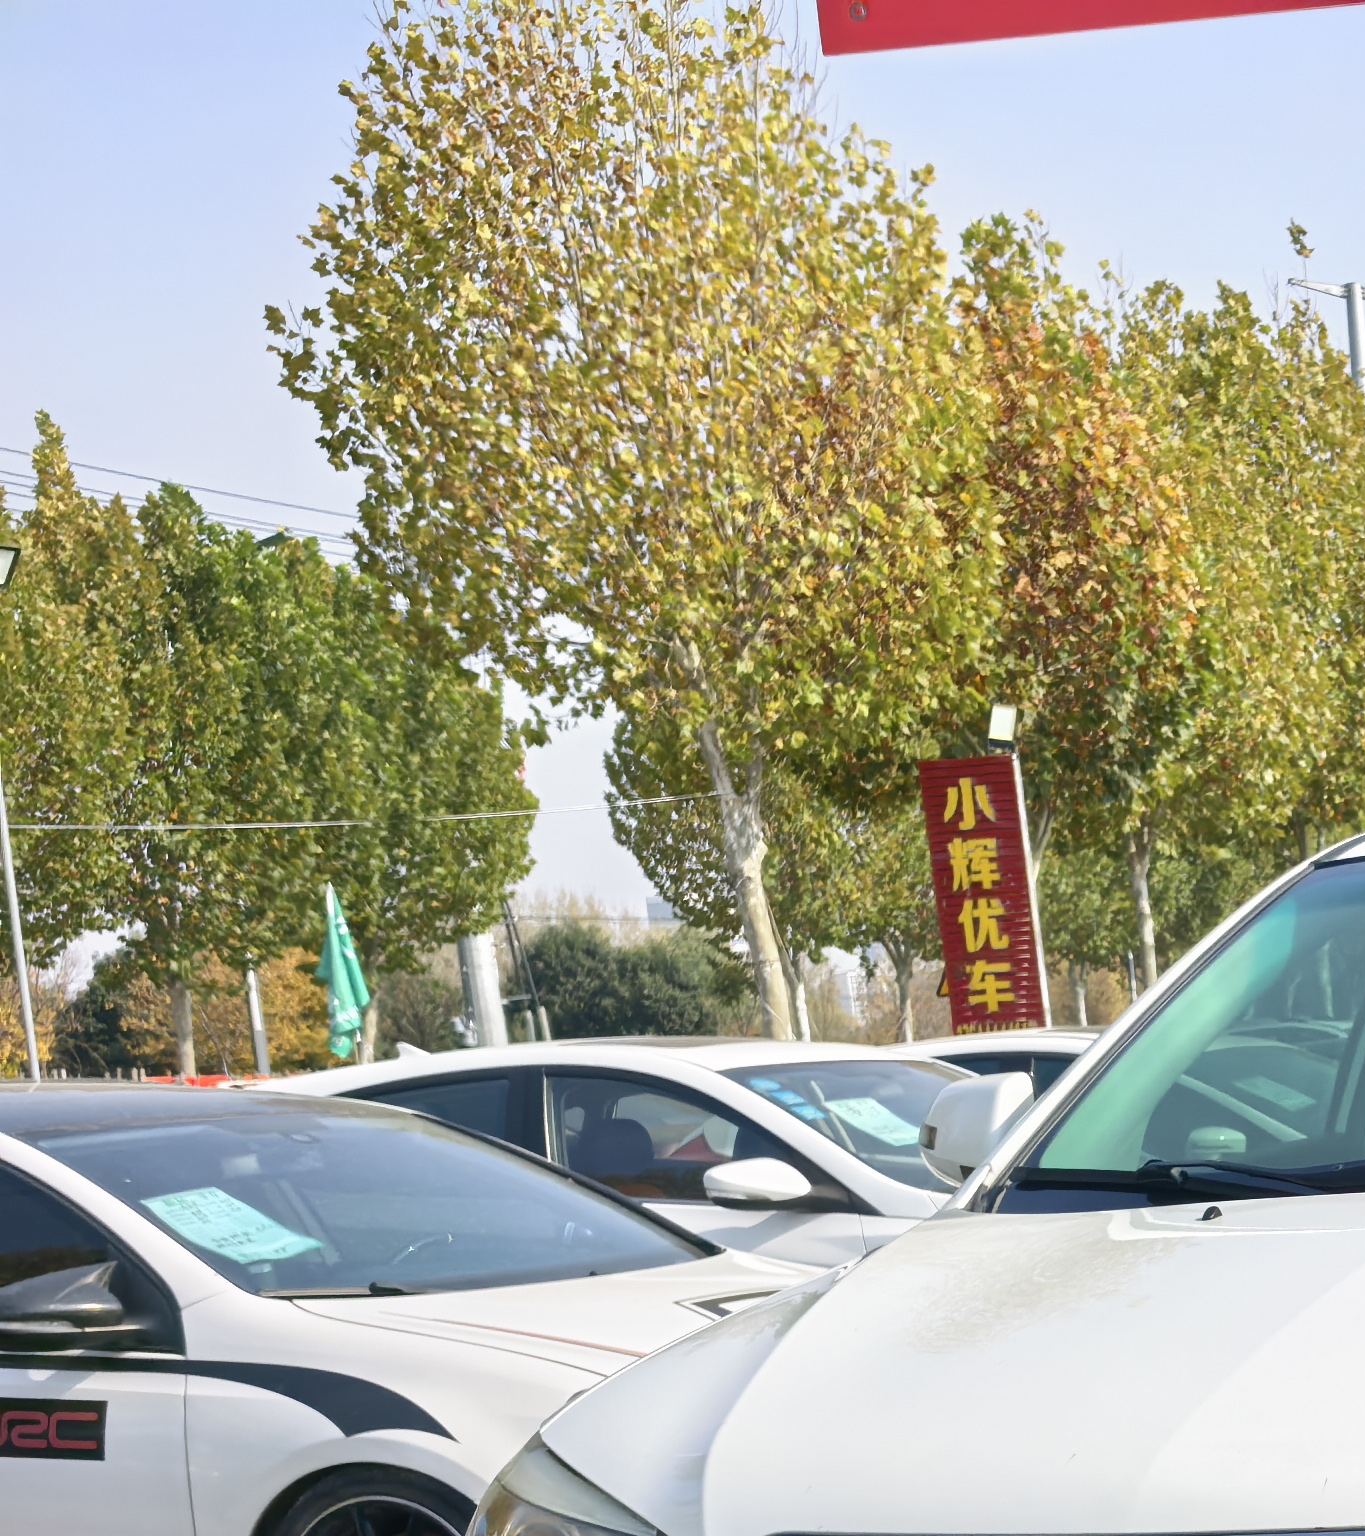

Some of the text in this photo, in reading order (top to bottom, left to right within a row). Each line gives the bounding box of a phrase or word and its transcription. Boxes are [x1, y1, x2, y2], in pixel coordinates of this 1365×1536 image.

[943, 776, 1016, 1013] 小辉优车
[0, 1410, 99, 1450] RC
